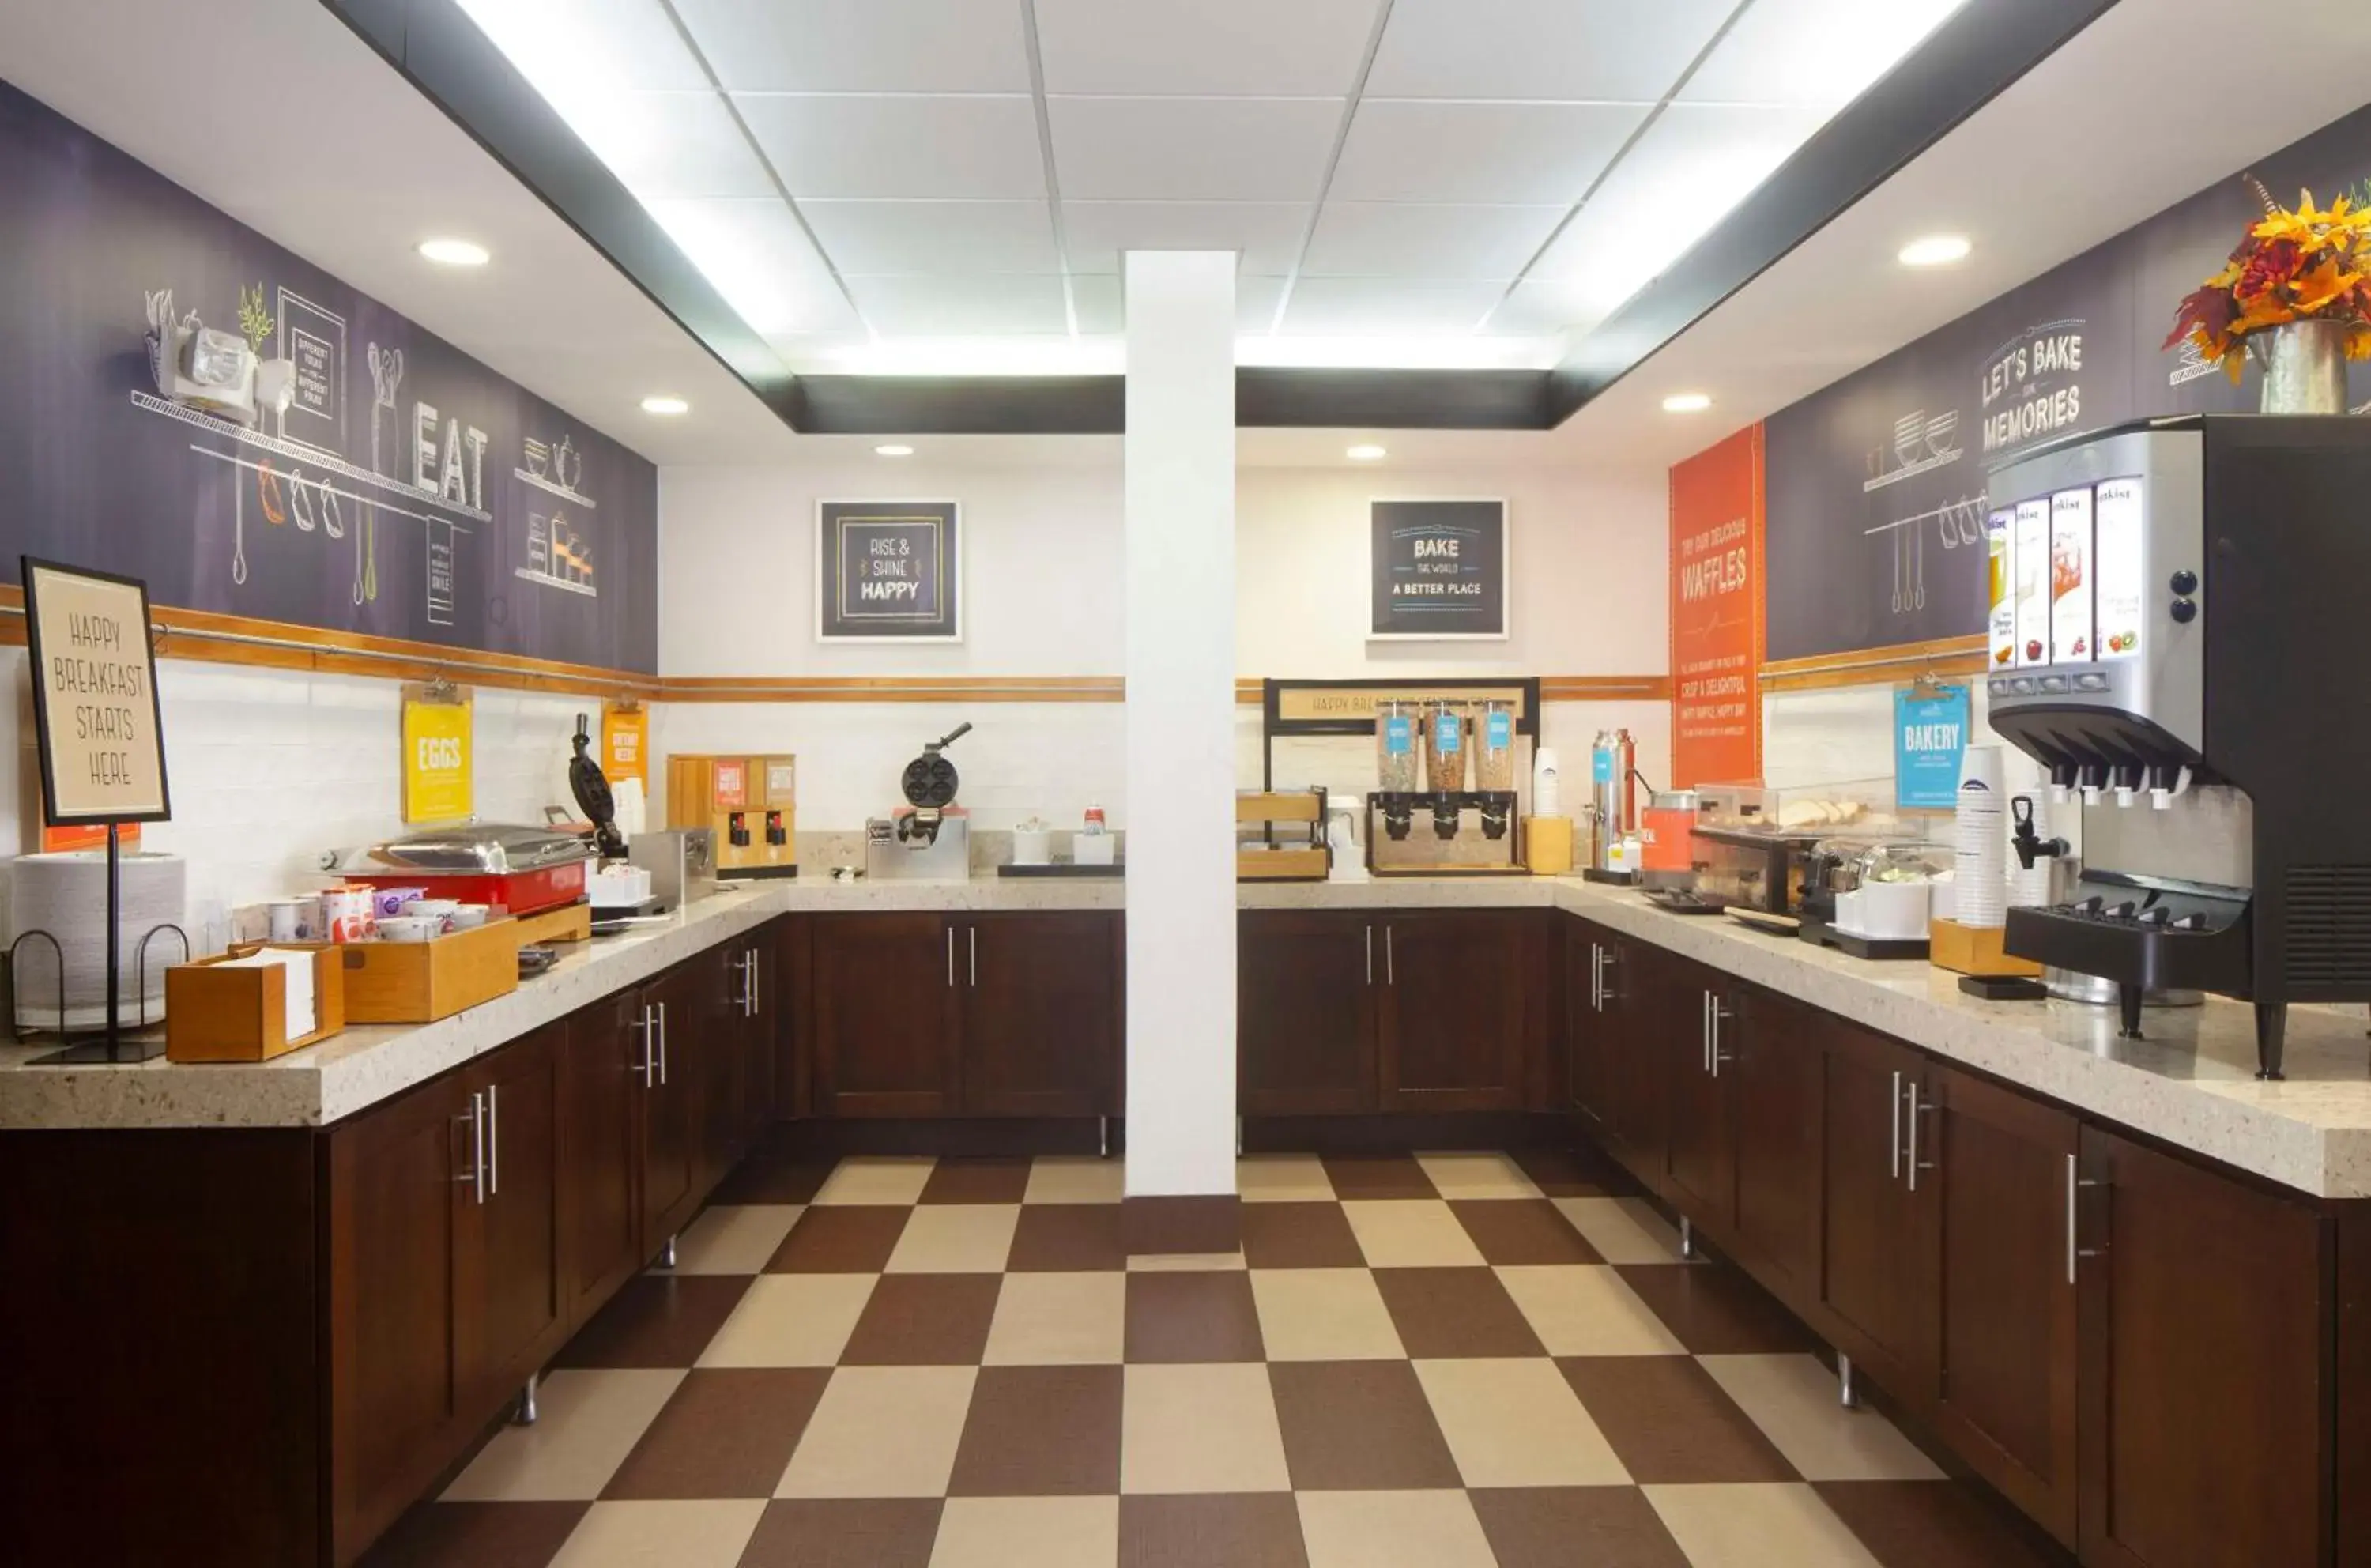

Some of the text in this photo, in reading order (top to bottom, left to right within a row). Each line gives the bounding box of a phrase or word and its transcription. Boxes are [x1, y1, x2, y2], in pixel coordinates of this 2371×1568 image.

[1982, 335, 2083, 409] LET'S BAKE
[1983, 384, 2080, 453] MEMORIES
[413, 401, 488, 510] EAT
[870, 538, 910, 556] RISE &
[1414, 539, 1460, 558] BAKE
[873, 559, 907, 576] SHINE
[1680, 546, 1747, 604] WAFFLES
[861, 581, 919, 601] HAPPY
[1393, 583, 1481, 594] A BETTER PLACE
[69, 612, 120, 652] HAPPY
[54, 657, 145, 697] BREAKFAST
[1313, 695, 1349, 710] HAPPY
[75, 706, 134, 741] STARTS
[1905, 723, 1960, 752] BAKERY
[89, 752, 132, 786] HERE
[418, 736, 462, 771] EGGS
